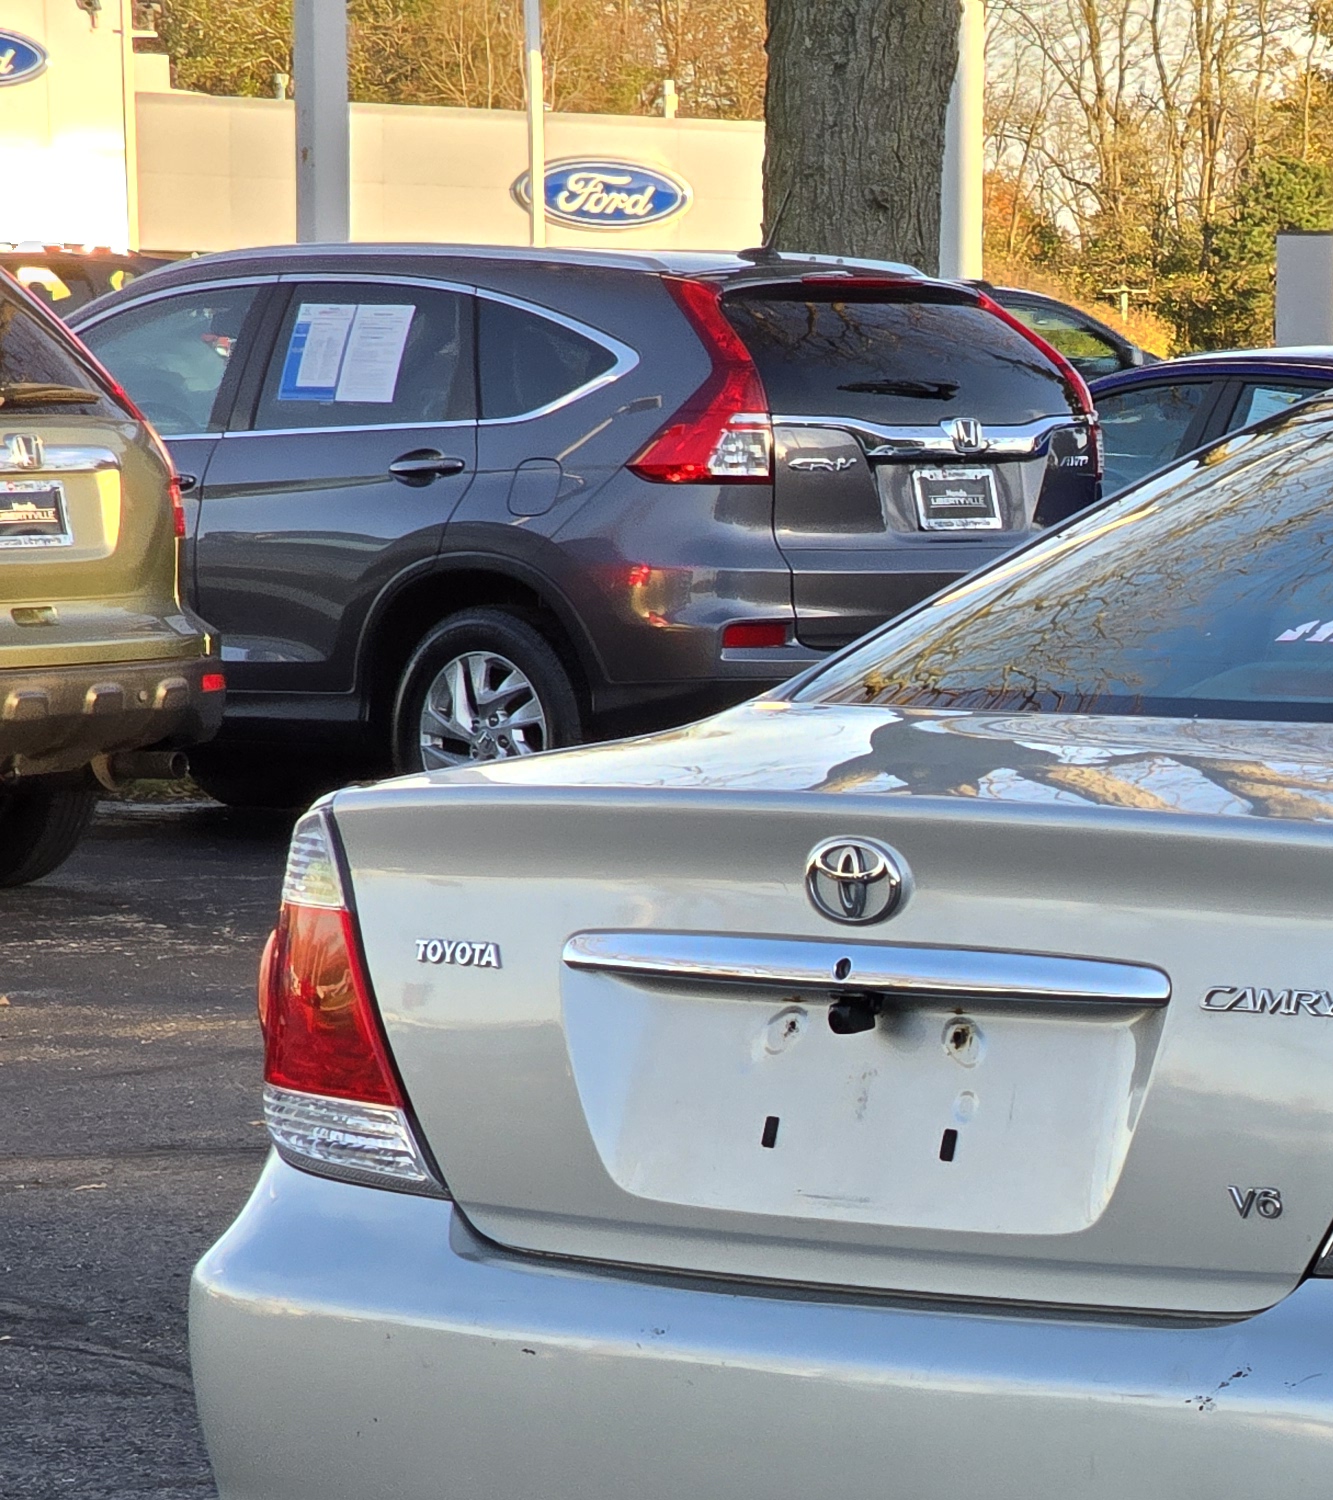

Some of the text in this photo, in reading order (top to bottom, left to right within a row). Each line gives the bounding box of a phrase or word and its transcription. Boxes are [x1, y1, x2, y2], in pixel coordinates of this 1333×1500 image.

[557, 172, 656, 216] Ford
[930, 497, 985, 505] LIBERTYVILLE
[415, 938, 502, 969] TOYOTA
[1227, 1184, 1283, 1219] V6
